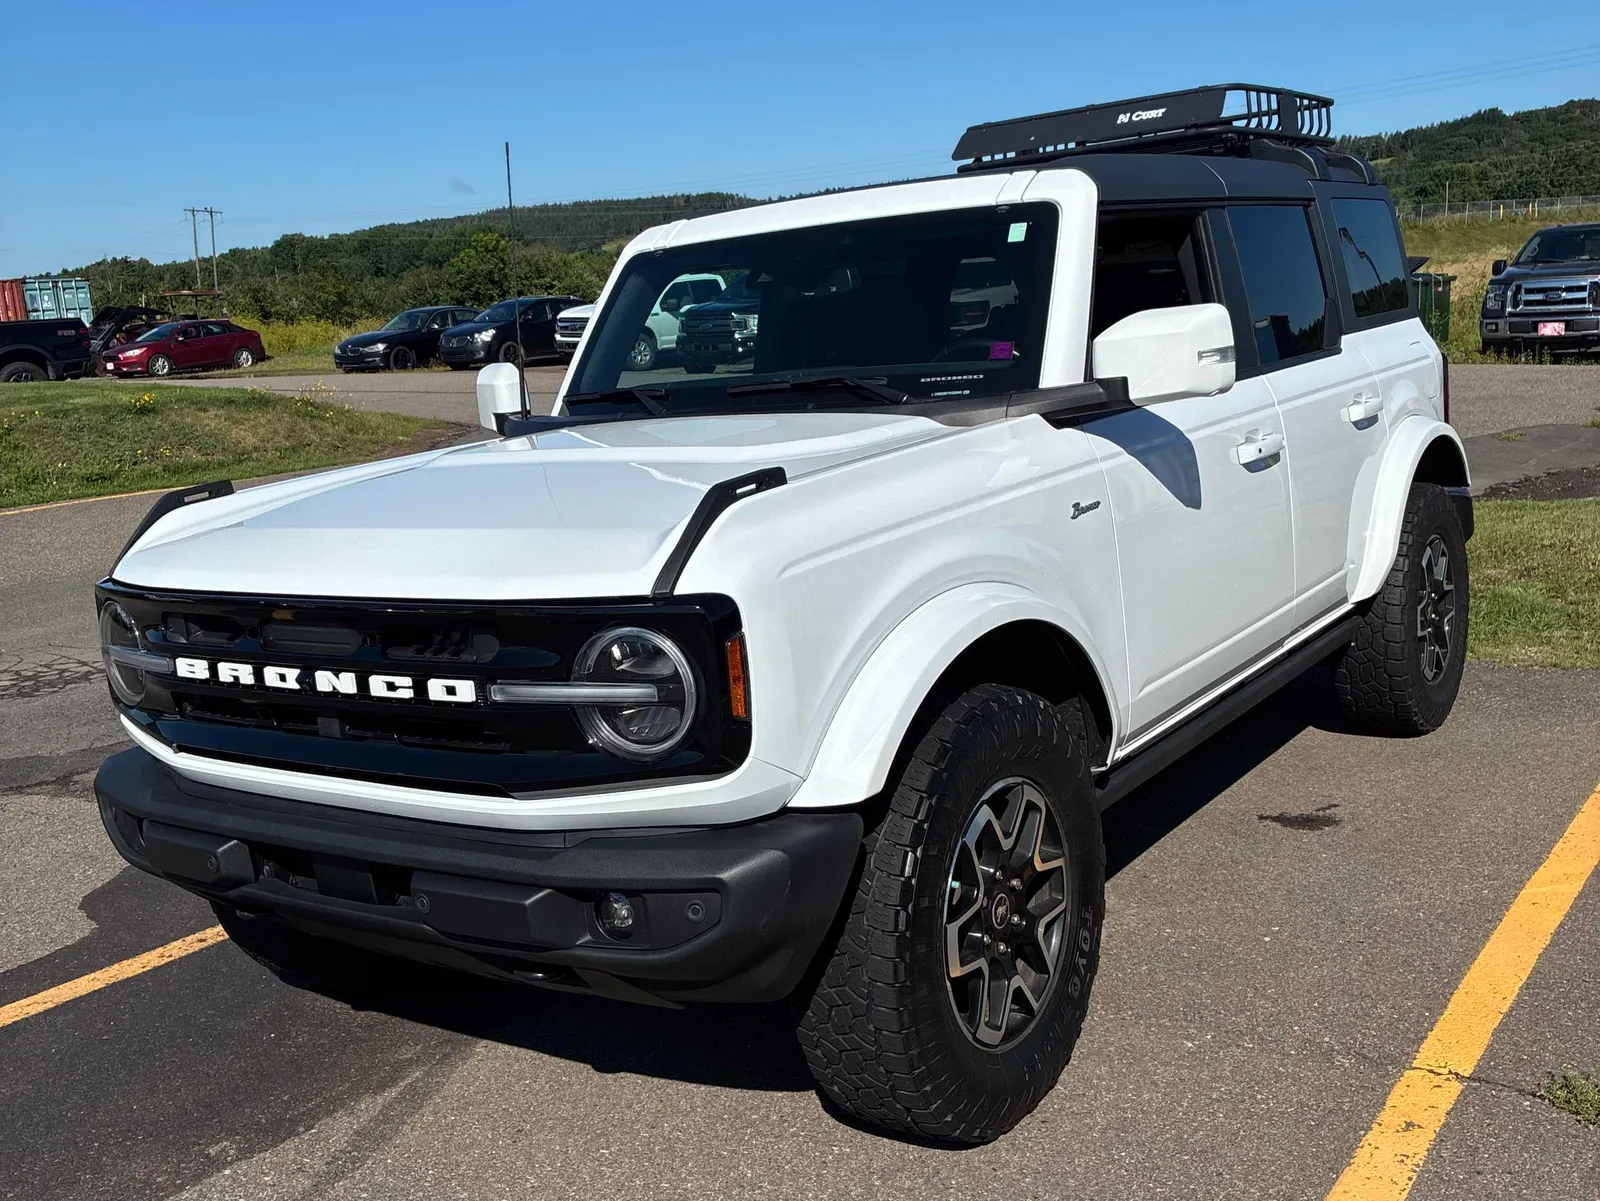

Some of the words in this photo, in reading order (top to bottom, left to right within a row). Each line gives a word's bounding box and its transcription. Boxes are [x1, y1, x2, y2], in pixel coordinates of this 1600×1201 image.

[1131, 107, 1168, 121] CURT
[175, 656, 478, 703] BRONCO
[1068, 905, 1094, 1000] TOYO
